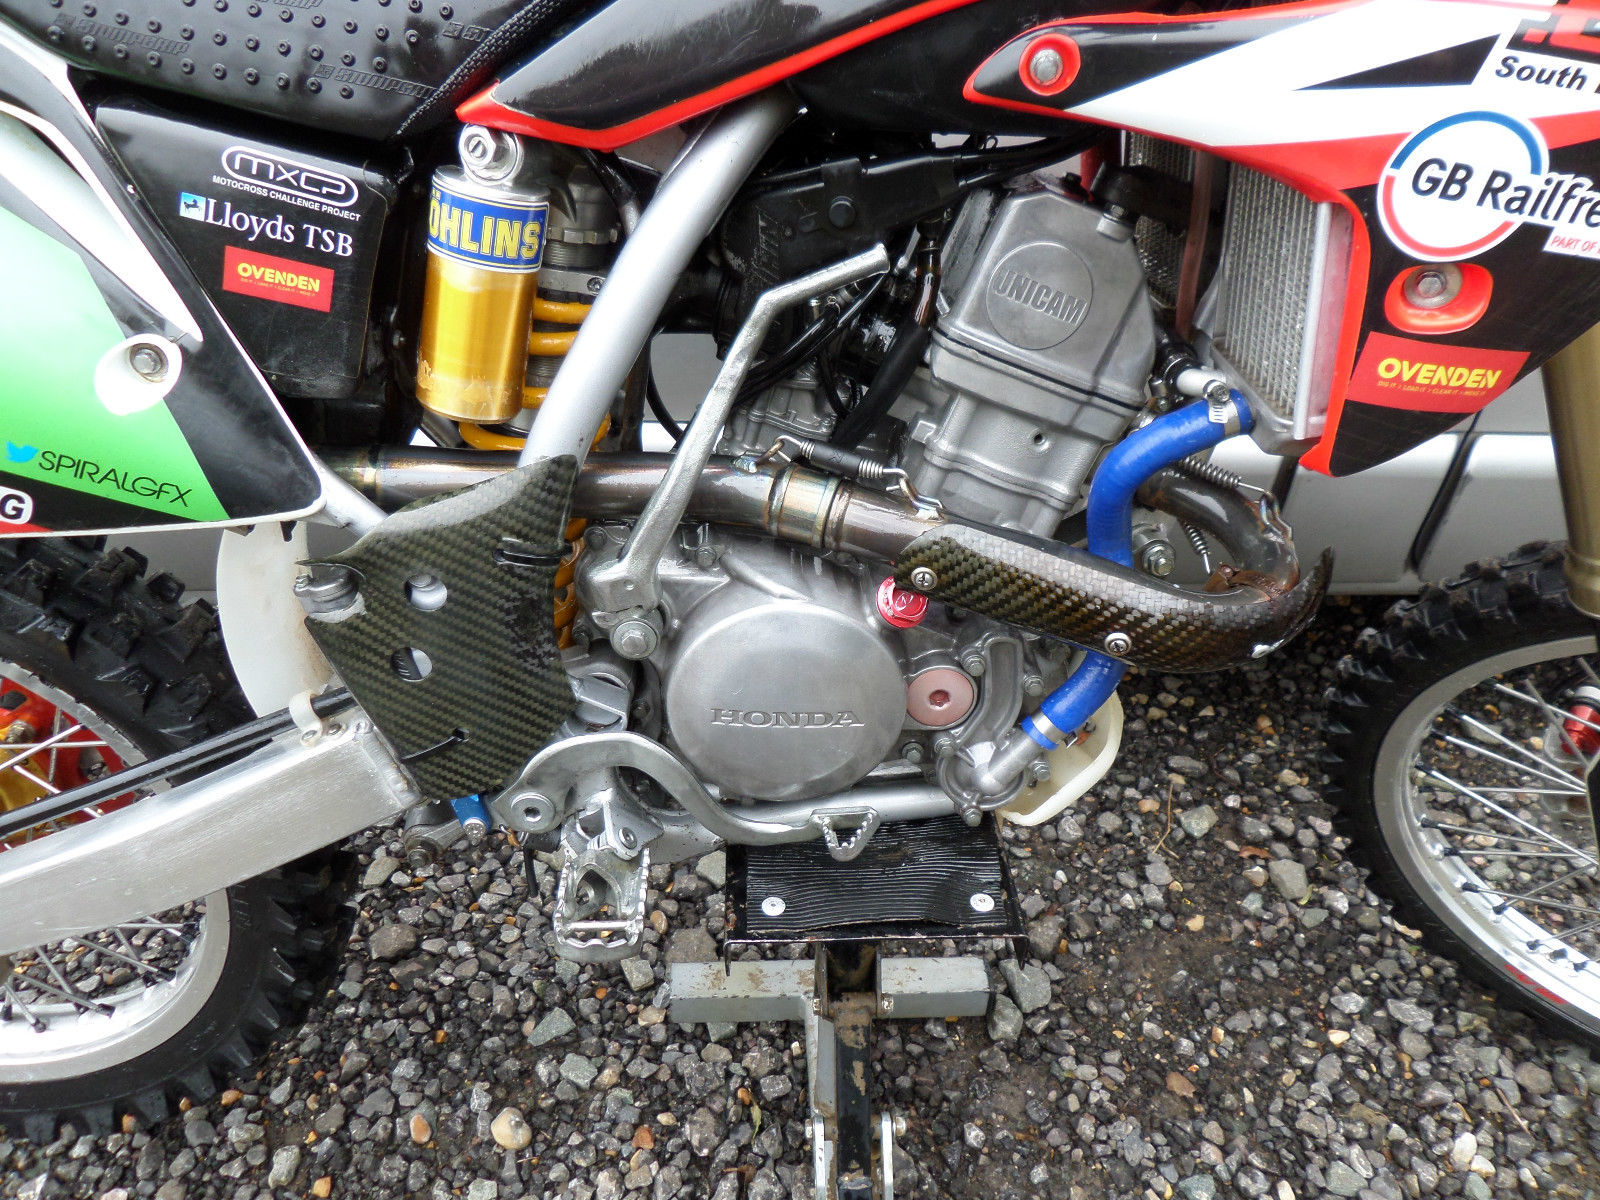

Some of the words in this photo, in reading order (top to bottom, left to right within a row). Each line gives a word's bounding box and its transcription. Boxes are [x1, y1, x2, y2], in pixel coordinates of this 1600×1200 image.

[1495, 55, 1588, 91] South
[212, 174, 268, 196] MOTOCROSS
[269, 190, 320, 211] CHALLENGE
[321, 204, 361, 222] PROJECT
[1411, 157, 1474, 202] GB
[1476, 169, 1600, 229] Railfre
[205, 198, 295, 243] Lloyds
[302, 223, 353, 257] TSB
[429, 187, 541, 260] ÖHLINS
[1550, 235, 1581, 249] PART
[237, 262, 320, 293] OVENDEN
[993, 269, 1087, 327] UNICAM
[1377, 357, 1502, 389] OVENDEN
[38, 450, 192, 507] SPIRALGFX
[710, 707, 865, 729] HONDA
